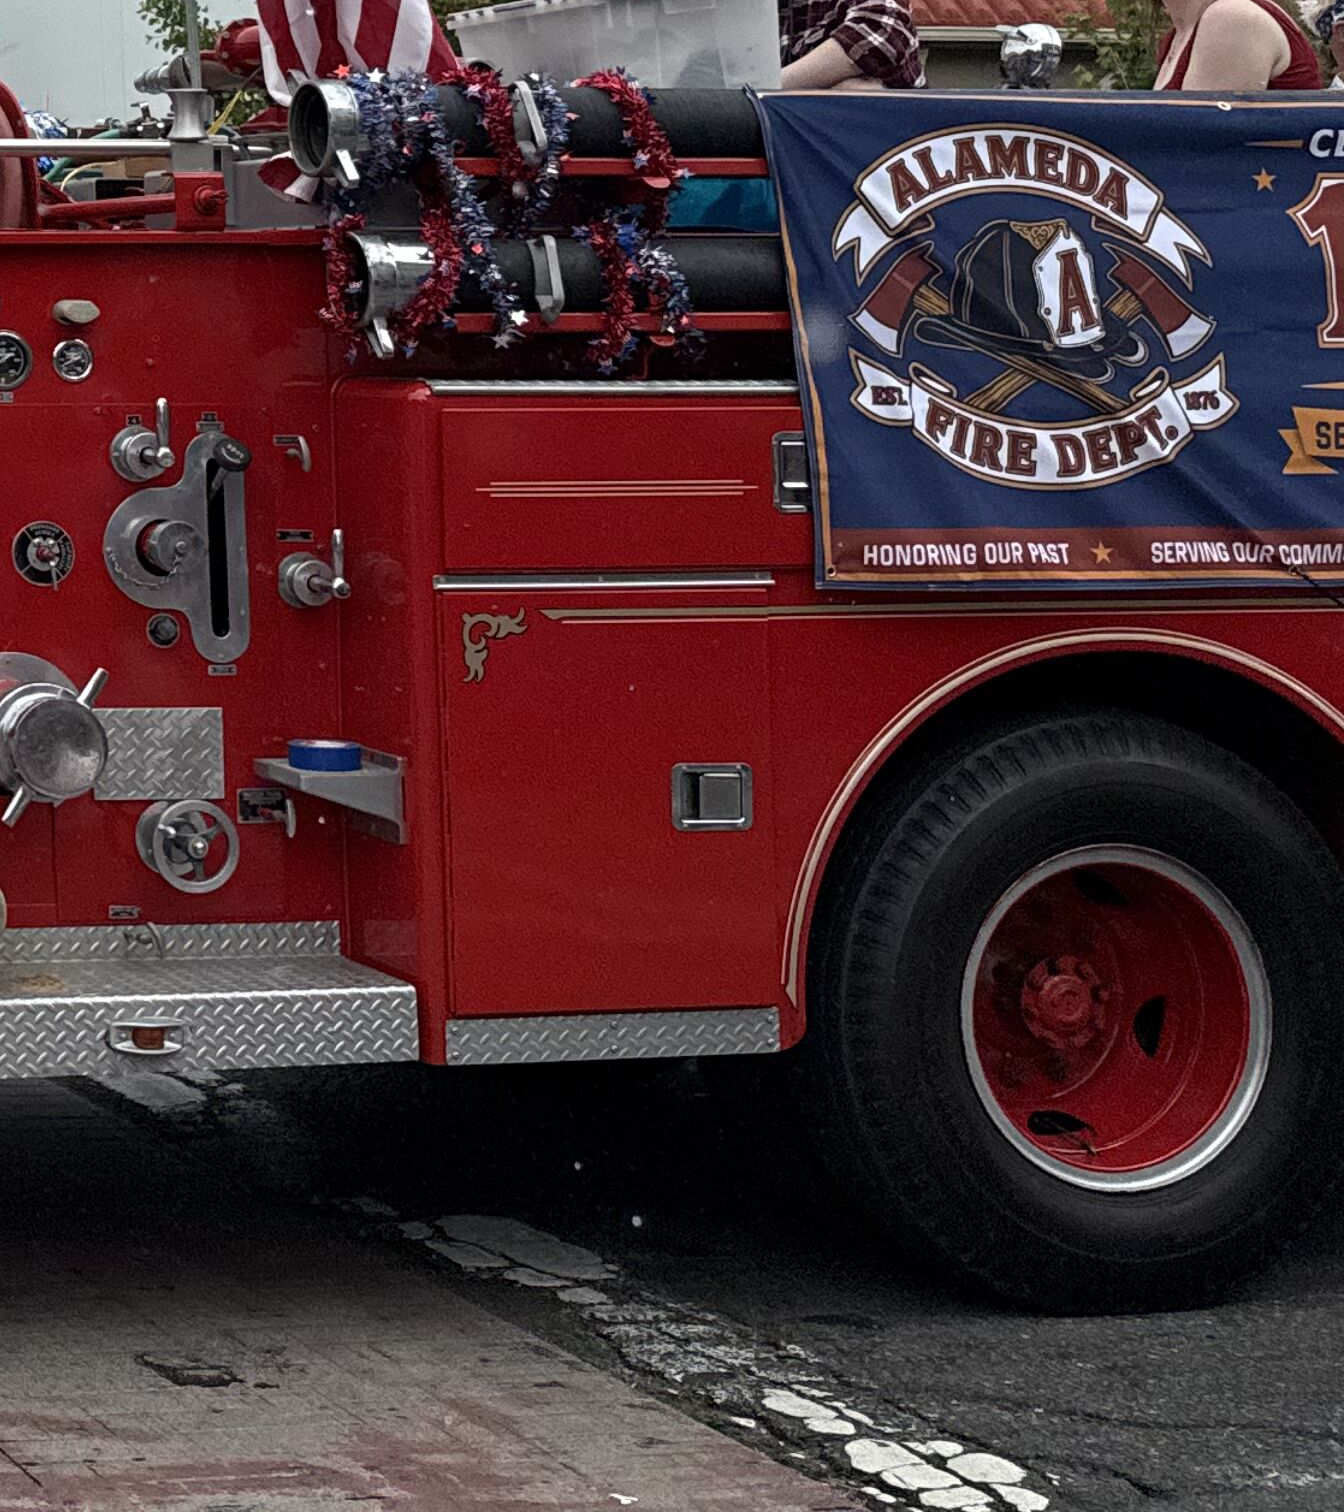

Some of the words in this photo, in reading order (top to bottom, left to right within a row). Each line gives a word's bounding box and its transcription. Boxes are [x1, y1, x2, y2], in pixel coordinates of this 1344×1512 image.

[885, 134, 1130, 220] ALAMEDA
[1055, 249, 1098, 336] A
[1182, 390, 1221, 411] 1876
[925, 397, 1037, 476] FIRE
[1052, 405, 1180, 477] DEPT.
[863, 542, 977, 567] HONORING
[983, 541, 1024, 566] OUR
[1028, 541, 1070, 566] PAST
[1150, 541, 1230, 565] SERVING
[1232, 541, 1274, 564] OUR
[1278, 542, 1344, 566] COMM
